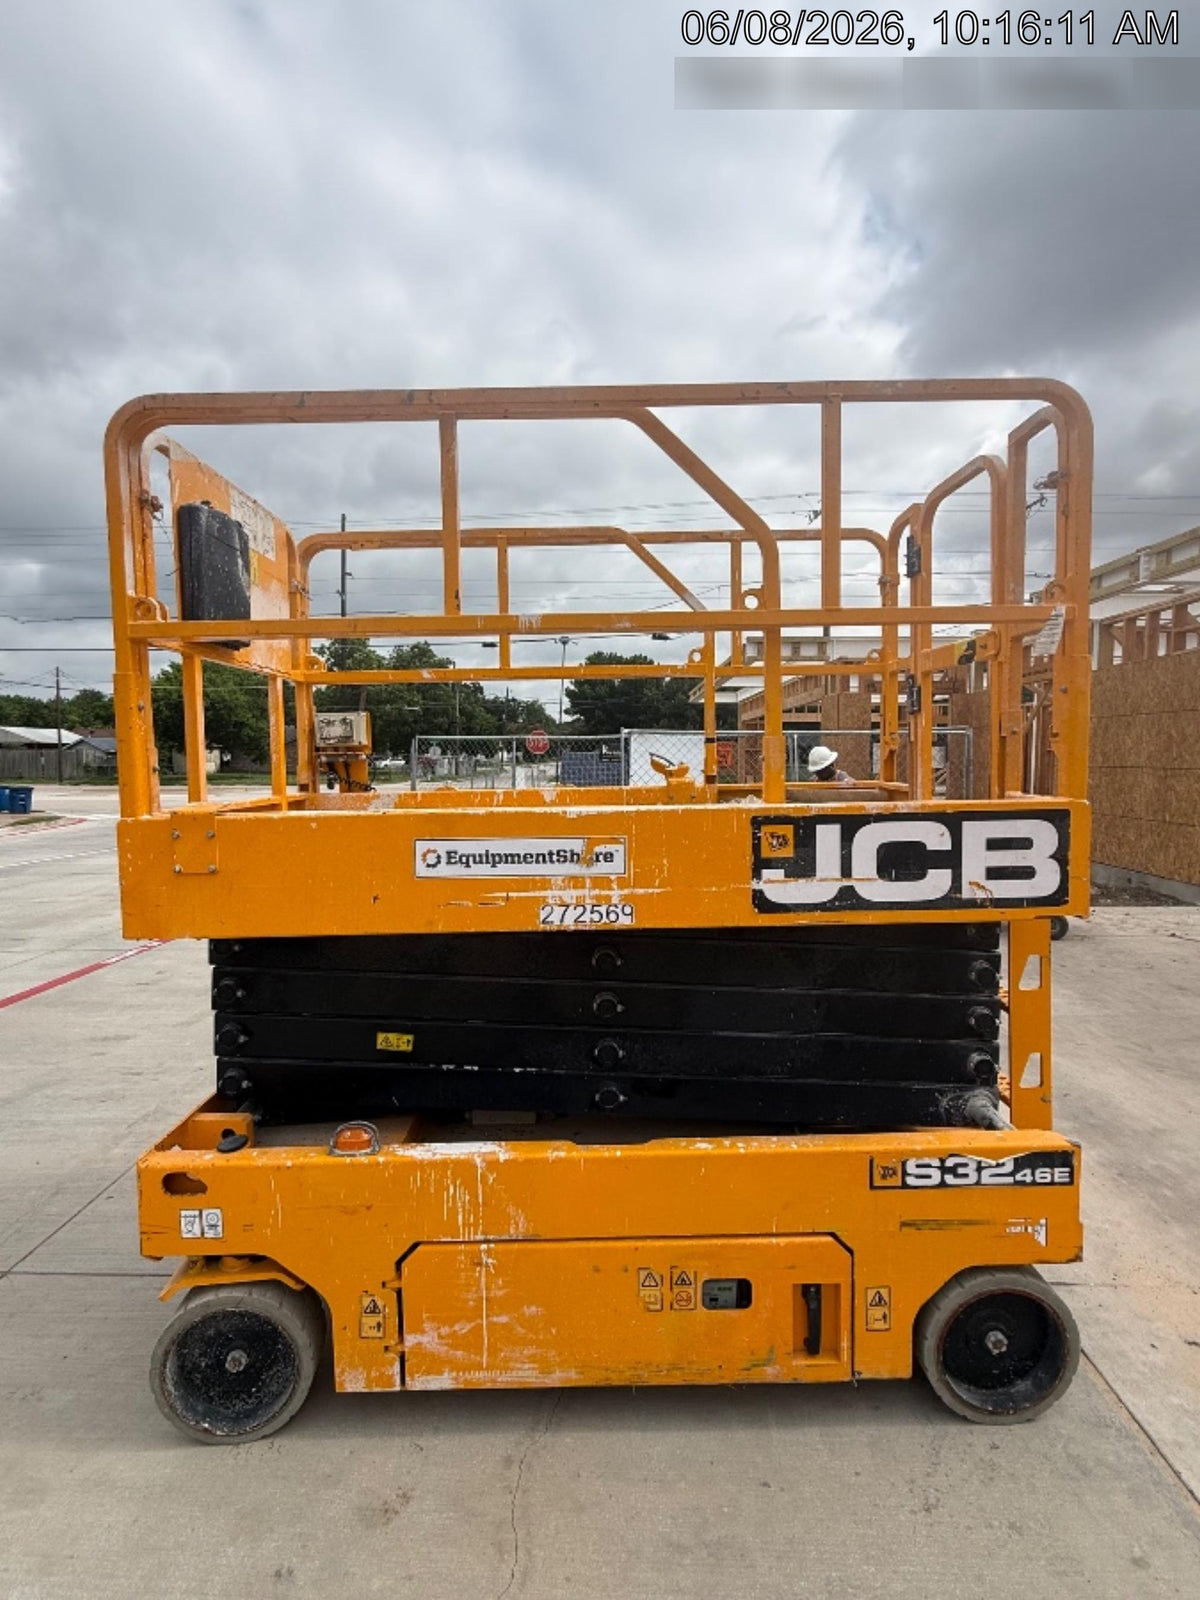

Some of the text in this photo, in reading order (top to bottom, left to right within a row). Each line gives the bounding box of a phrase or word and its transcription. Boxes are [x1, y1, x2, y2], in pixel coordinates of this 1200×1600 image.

[446, 848, 615, 868] EquipmentShre
[760, 819, 1062, 904] JCB
[540, 904, 634, 925] 272569
